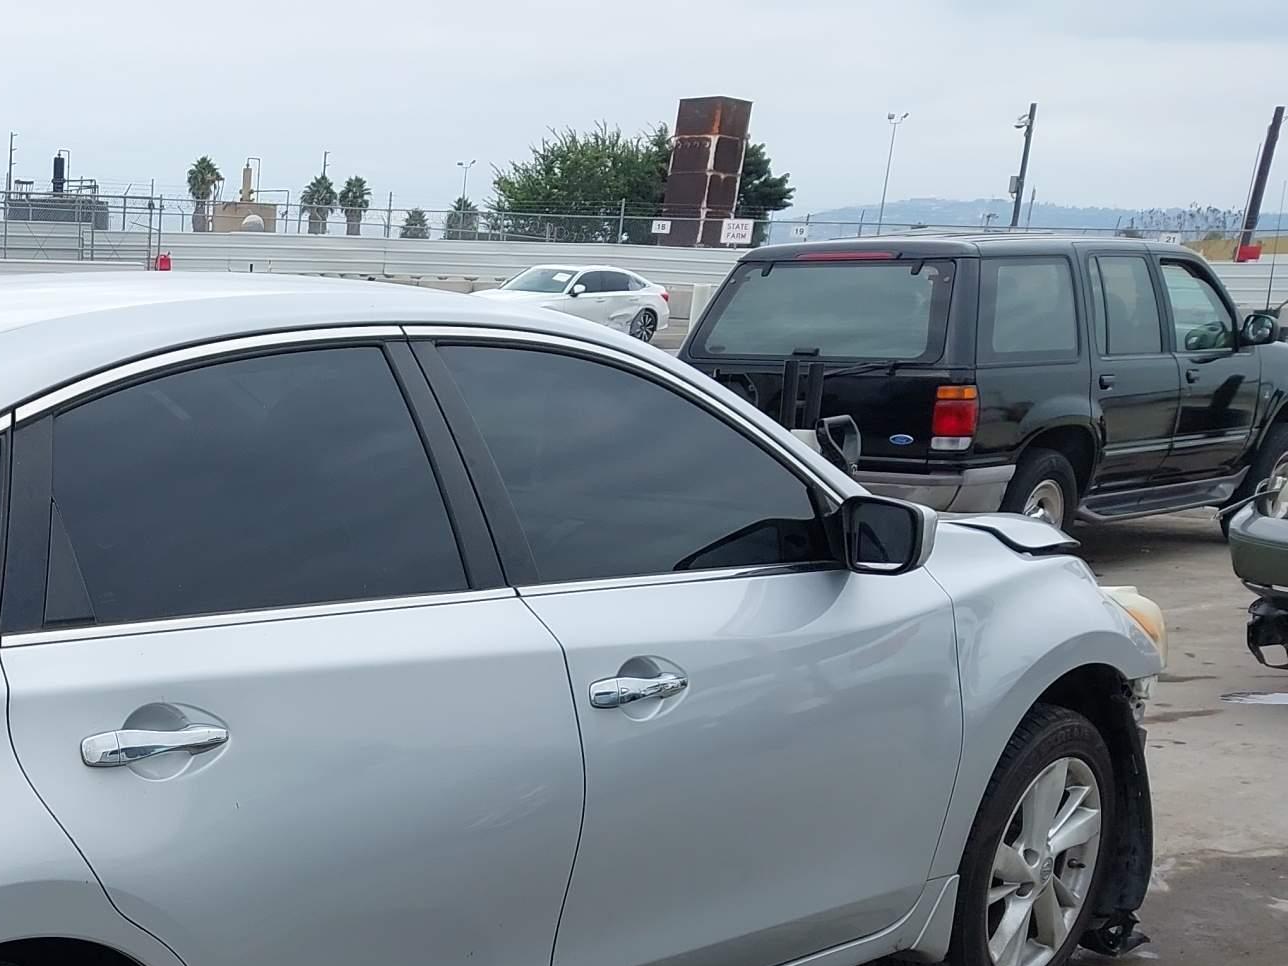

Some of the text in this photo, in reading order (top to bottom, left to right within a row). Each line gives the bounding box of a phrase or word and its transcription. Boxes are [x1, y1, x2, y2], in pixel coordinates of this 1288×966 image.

[727, 223, 749, 231] STATE
[795, 227, 805, 236] 19
[726, 232, 747, 240] FARM
[1166, 235, 1176, 244] 21
